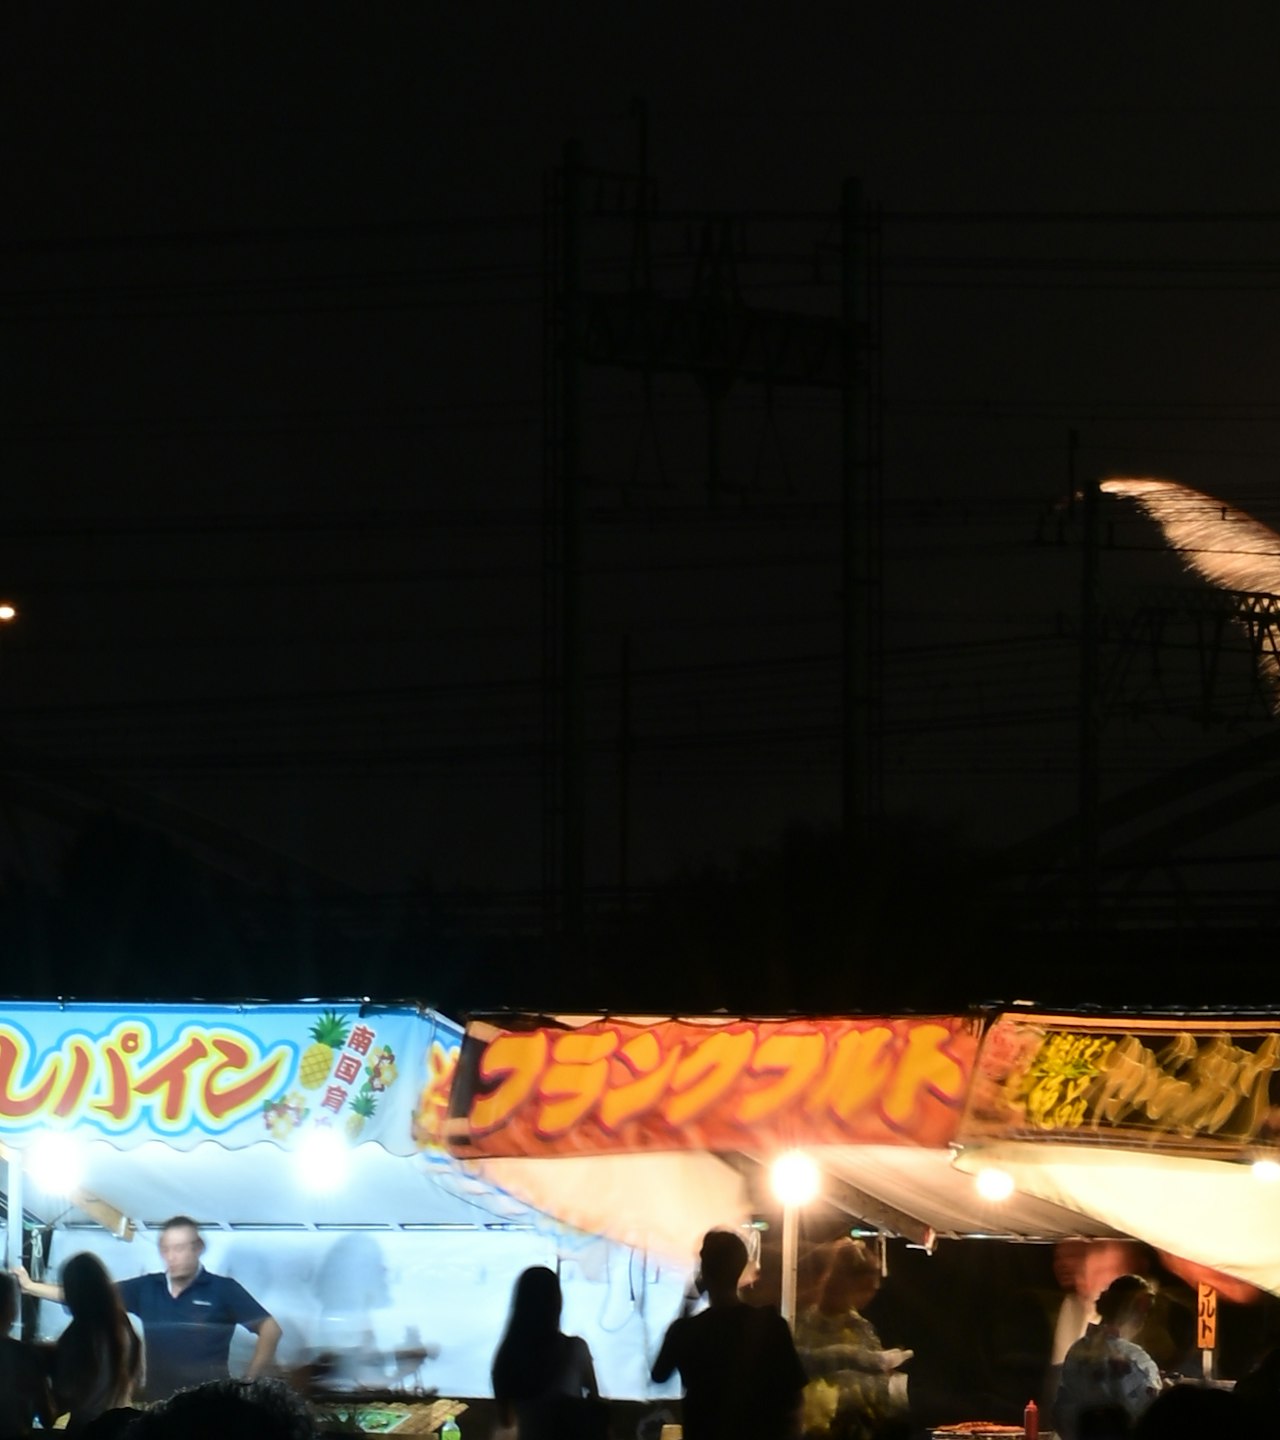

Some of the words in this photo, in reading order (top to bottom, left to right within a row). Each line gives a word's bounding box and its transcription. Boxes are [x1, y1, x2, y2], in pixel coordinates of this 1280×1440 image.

[469, 1025, 964, 1136] フランクフルト
